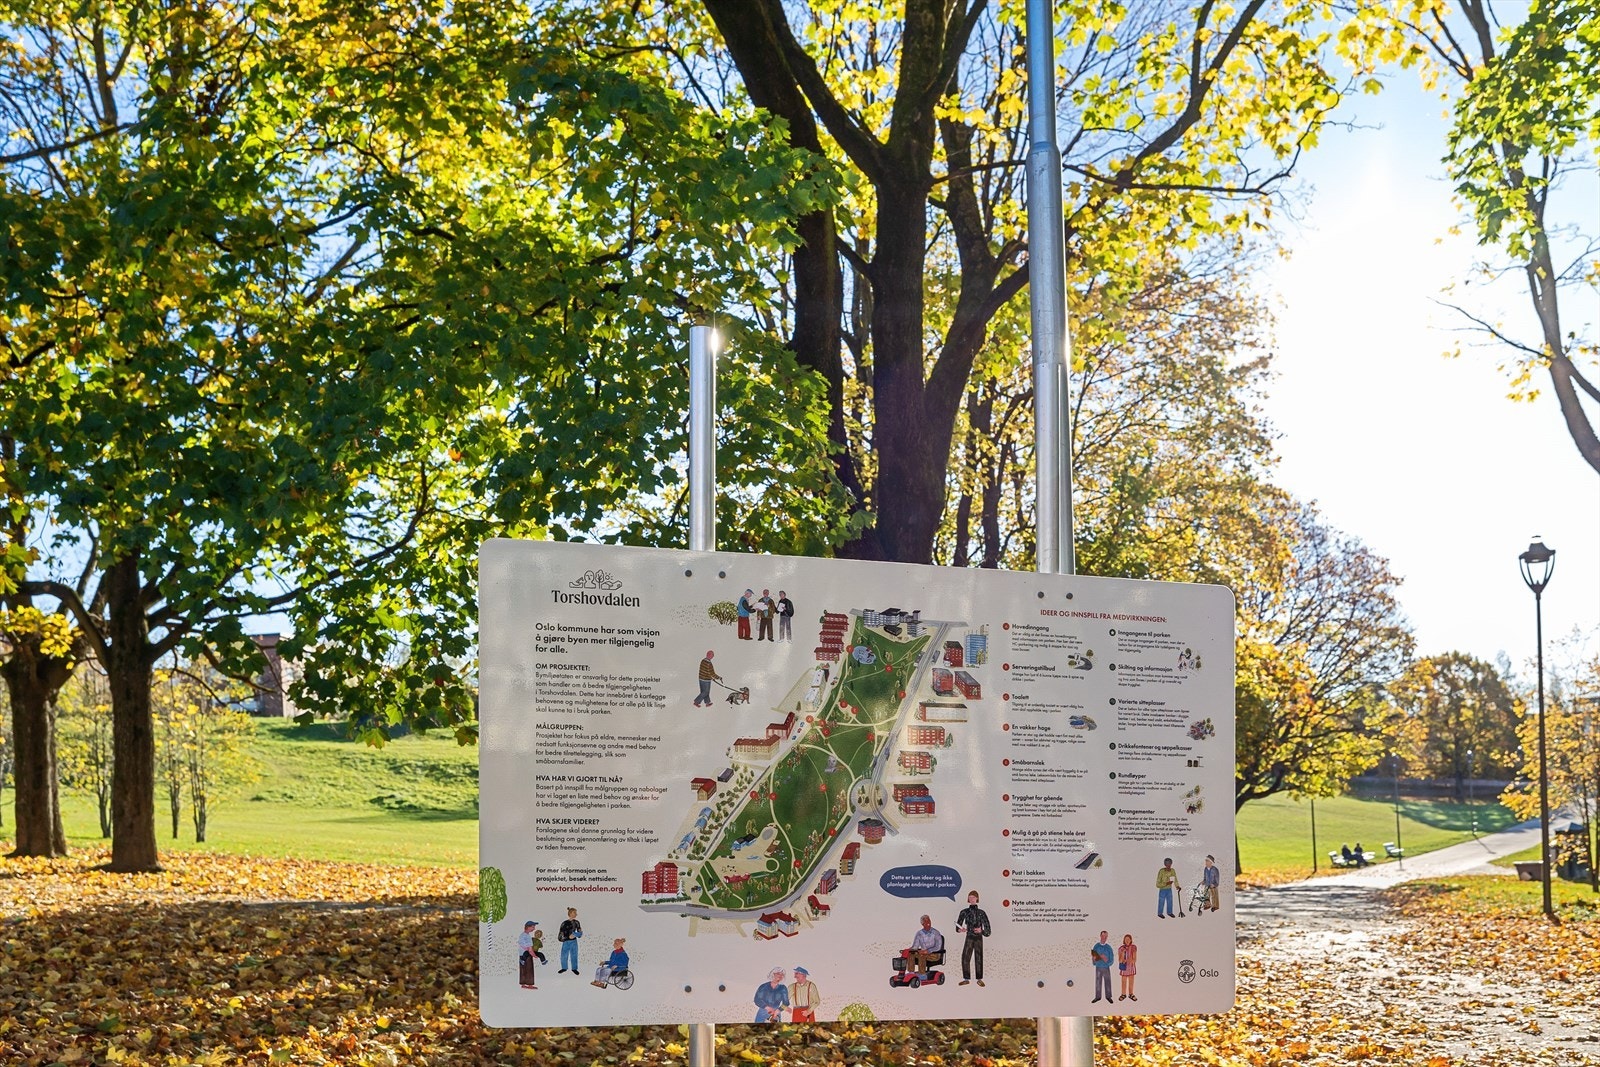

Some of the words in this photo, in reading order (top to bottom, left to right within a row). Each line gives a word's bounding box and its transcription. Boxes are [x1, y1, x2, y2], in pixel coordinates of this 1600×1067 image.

[552, 590, 640, 607] Torshovdalen
[1112, 614, 1167, 622] MEDVIRKNINGEN:
[535, 623, 555, 631] Oslo
[557, 624, 598, 633] kommune
[600, 626, 615, 634] har
[636, 627, 660, 638] visjon
[543, 634, 565, 644] gjøre
[568, 635, 588, 646] byen
[609, 637, 654, 648] tilgjengelig
[536, 645, 547, 653] for
[550, 645, 568, 654] alle.
[606, 683, 651, 692] tilgjengeligheten
[536, 722, 584, 731] MÅLGRUPPEN:
[536, 732, 562, 740] Prosjektet
[564, 784, 584, 792] innspill
[594, 784, 628, 793] målgruppen
[639, 785, 668, 793] nabolaget
[560, 801, 606, 809] tilgjengeligheten
[536, 827, 567, 835] Forslagene
[601, 828, 626, 836] grunnlag
[536, 884, 624, 893] www.torshovdalen.org
[1200, 968, 1219, 977] Oslo
